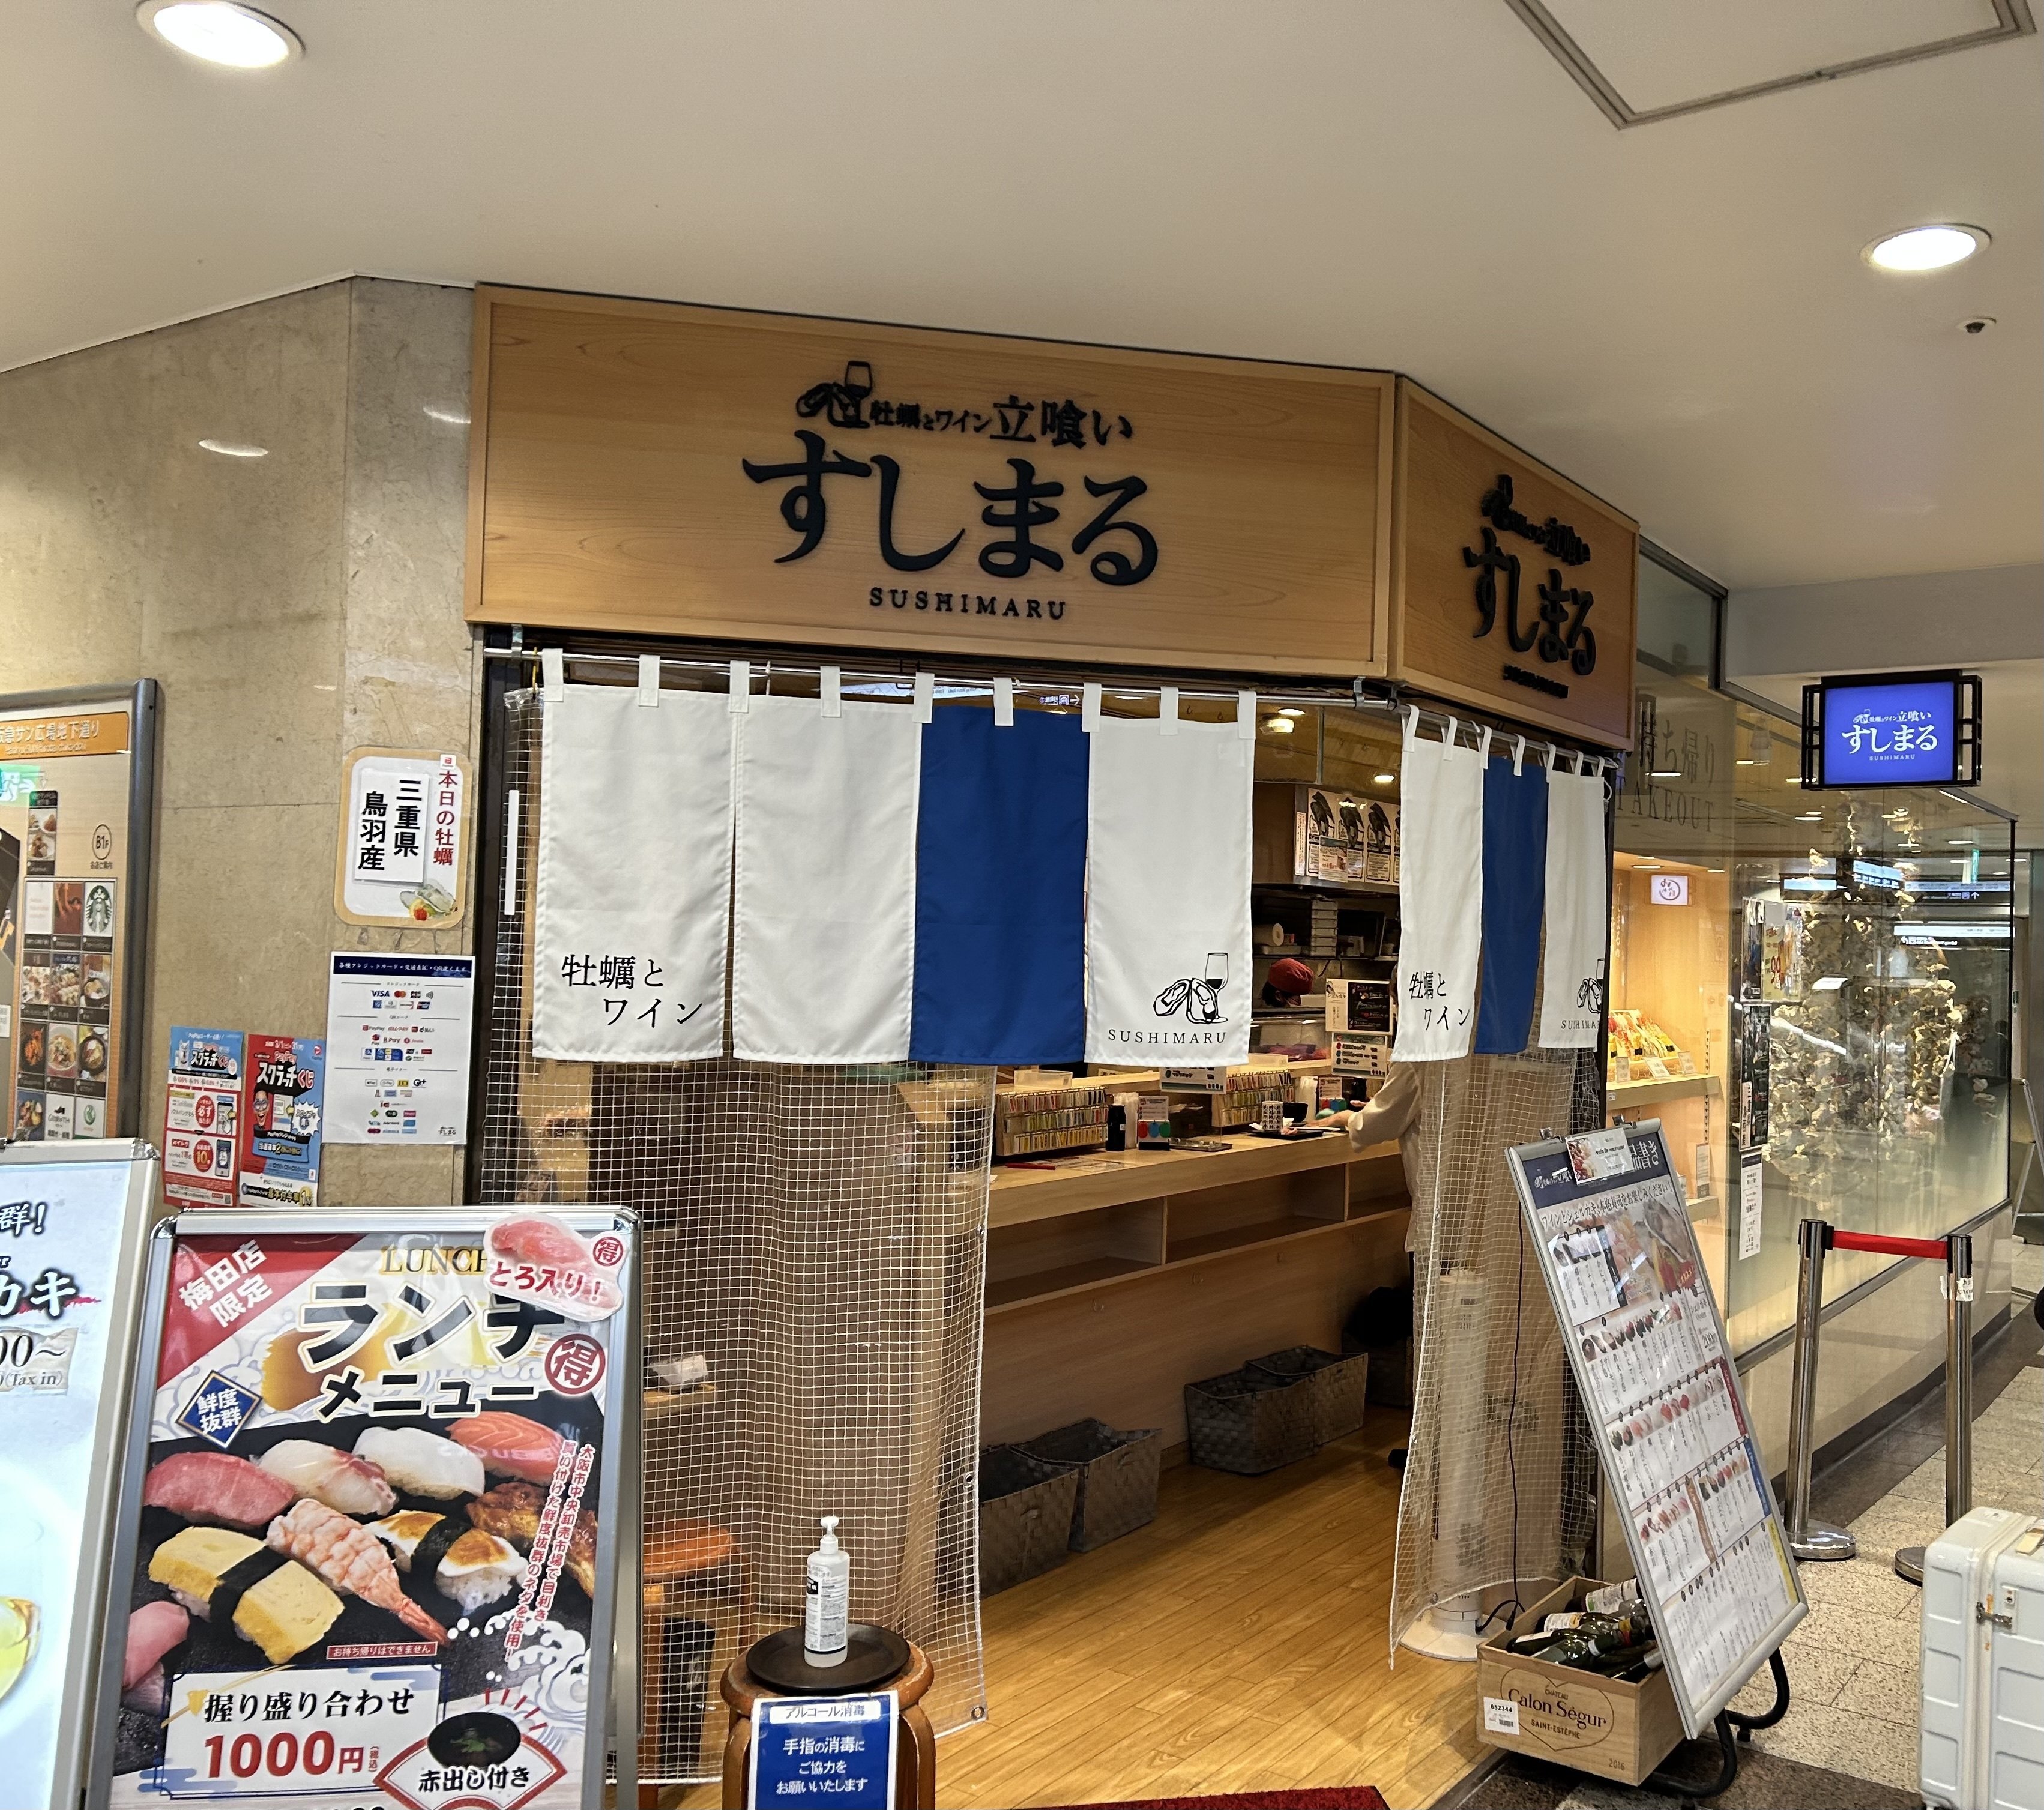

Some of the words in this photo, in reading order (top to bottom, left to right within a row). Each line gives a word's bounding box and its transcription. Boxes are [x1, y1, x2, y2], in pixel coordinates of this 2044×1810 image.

[742, 430, 1159, 586] すしまる
[870, 587, 1066, 620] SUSHIMARU
[1463, 526, 1596, 675] すしまる
[1841, 725, 1938, 755] すしまる
[394, 779, 423, 857] 三重県
[433, 771, 457, 866] 本日の牡蠣
[1617, 782, 1714, 833] TAKEOUT
[358, 791, 388, 870] 鳥羽産
[561, 954, 663, 989] 牡蠣と
[603, 998, 703, 1028] ワイン
[1424, 1006, 1470, 1031] ワイン
[1108, 1029, 1226, 1044] SUSHIMARU
[256, 1061, 315, 1089] スクラッチくじ
[179, 1238, 268, 1311] 梅田店
[209, 1275, 274, 1328] 限定
[301, 1284, 565, 1366] ランチ
[550, 1338, 600, 1392] 得
[196, 1387, 238, 1413] 鮮度
[318, 1372, 538, 1420] メニュー
[200, 1408, 243, 1435] 抜群
[533, 1443, 595, 1623] 大阪市中央卸売市場で目利き
[333, 1645, 431, 1658] お持ち帰りはできません
[203, 1688, 415, 1724] 握り盛り合わせ
[784, 1704, 866, 1719] アルコール消毒
[1507, 1688, 1552, 1715] Calon
[1556, 1701, 1607, 1730] Ségur
[203, 1729, 361, 1778] 1000円
[783, 1736, 866, 1755] 手指の消毒に
[417, 1765, 530, 1794] 赤出し付き
[798, 1760, 847, 1775] ご協力を
[776, 1778, 868, 1796] お願いいたします
